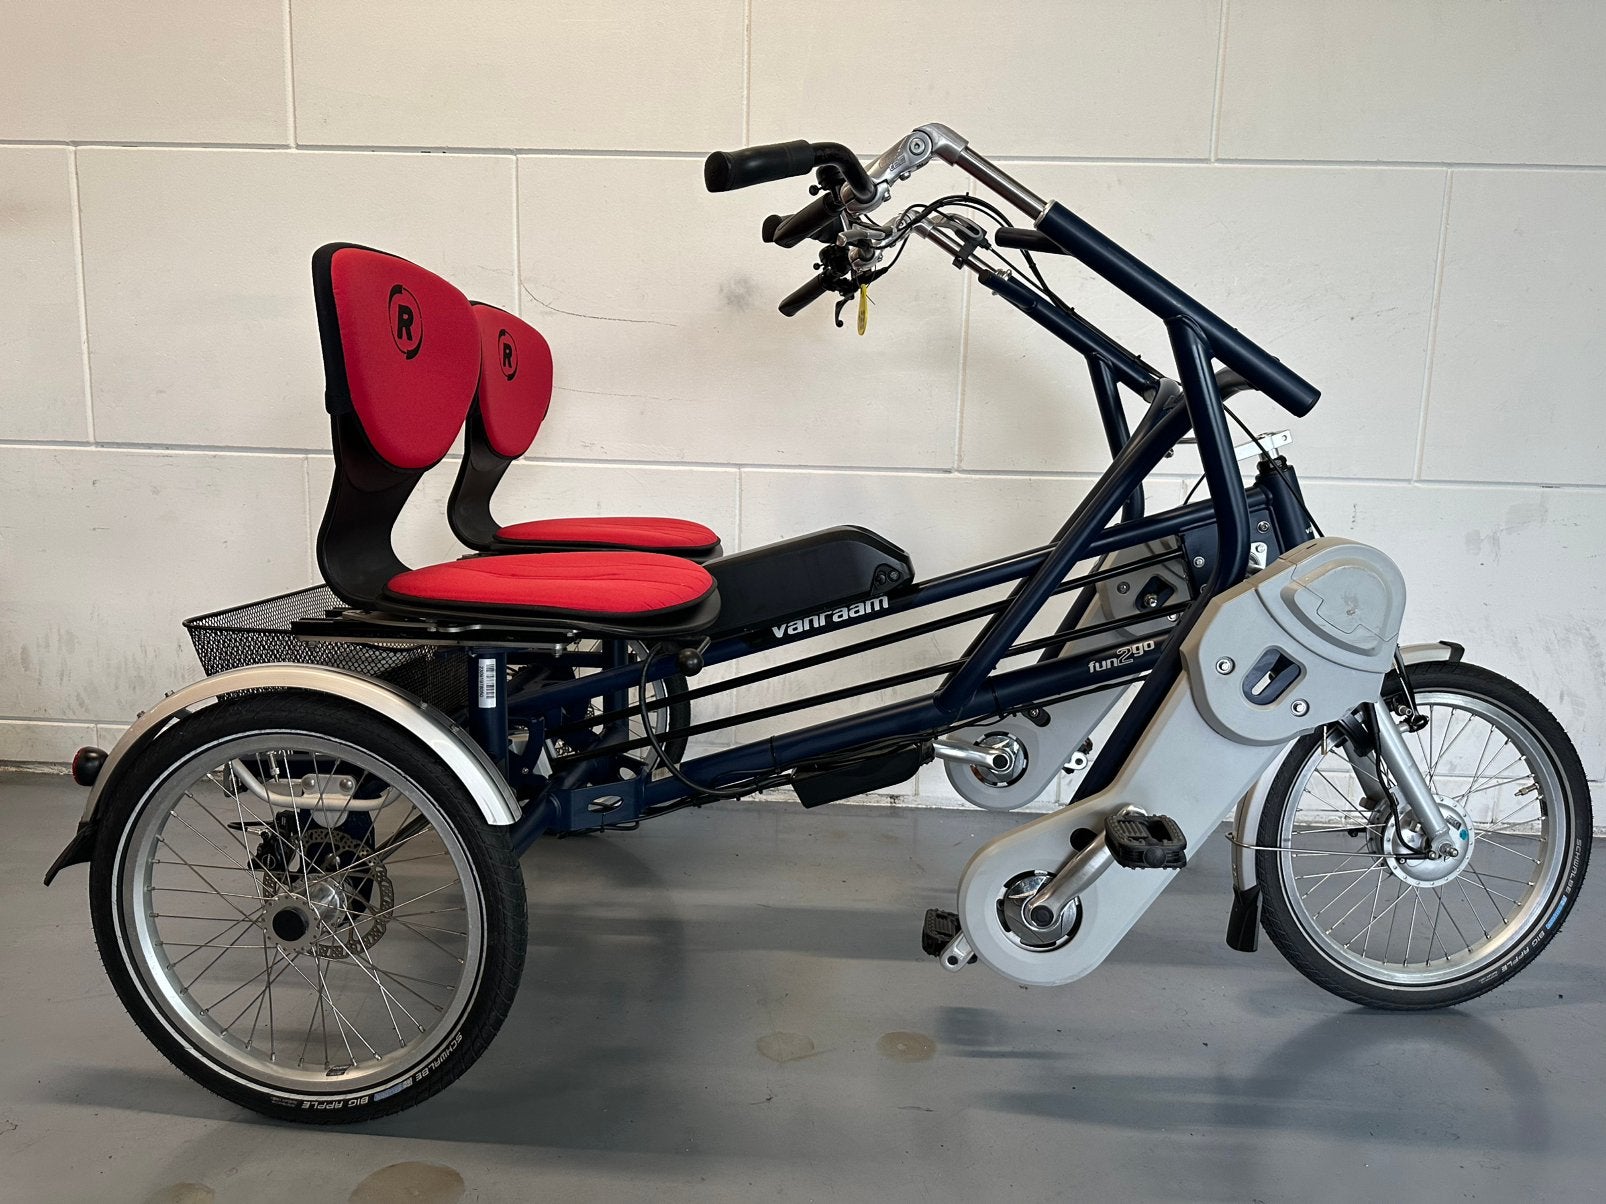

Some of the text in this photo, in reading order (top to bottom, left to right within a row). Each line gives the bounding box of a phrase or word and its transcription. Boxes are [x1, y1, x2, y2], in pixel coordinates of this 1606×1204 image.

[397, 304, 414, 341] R
[503, 342, 513, 368] R
[771, 595, 889, 638] vanraam
[1088, 640, 1155, 673] fun2go
[1565, 838, 1582, 895] SCHWALBE
[1501, 930, 1545, 972] BIG APPLE
[415, 1031, 463, 1082] SCHWALBE
[302, 1101, 343, 1109] APPLE
[347, 1096, 369, 1107] BIG
